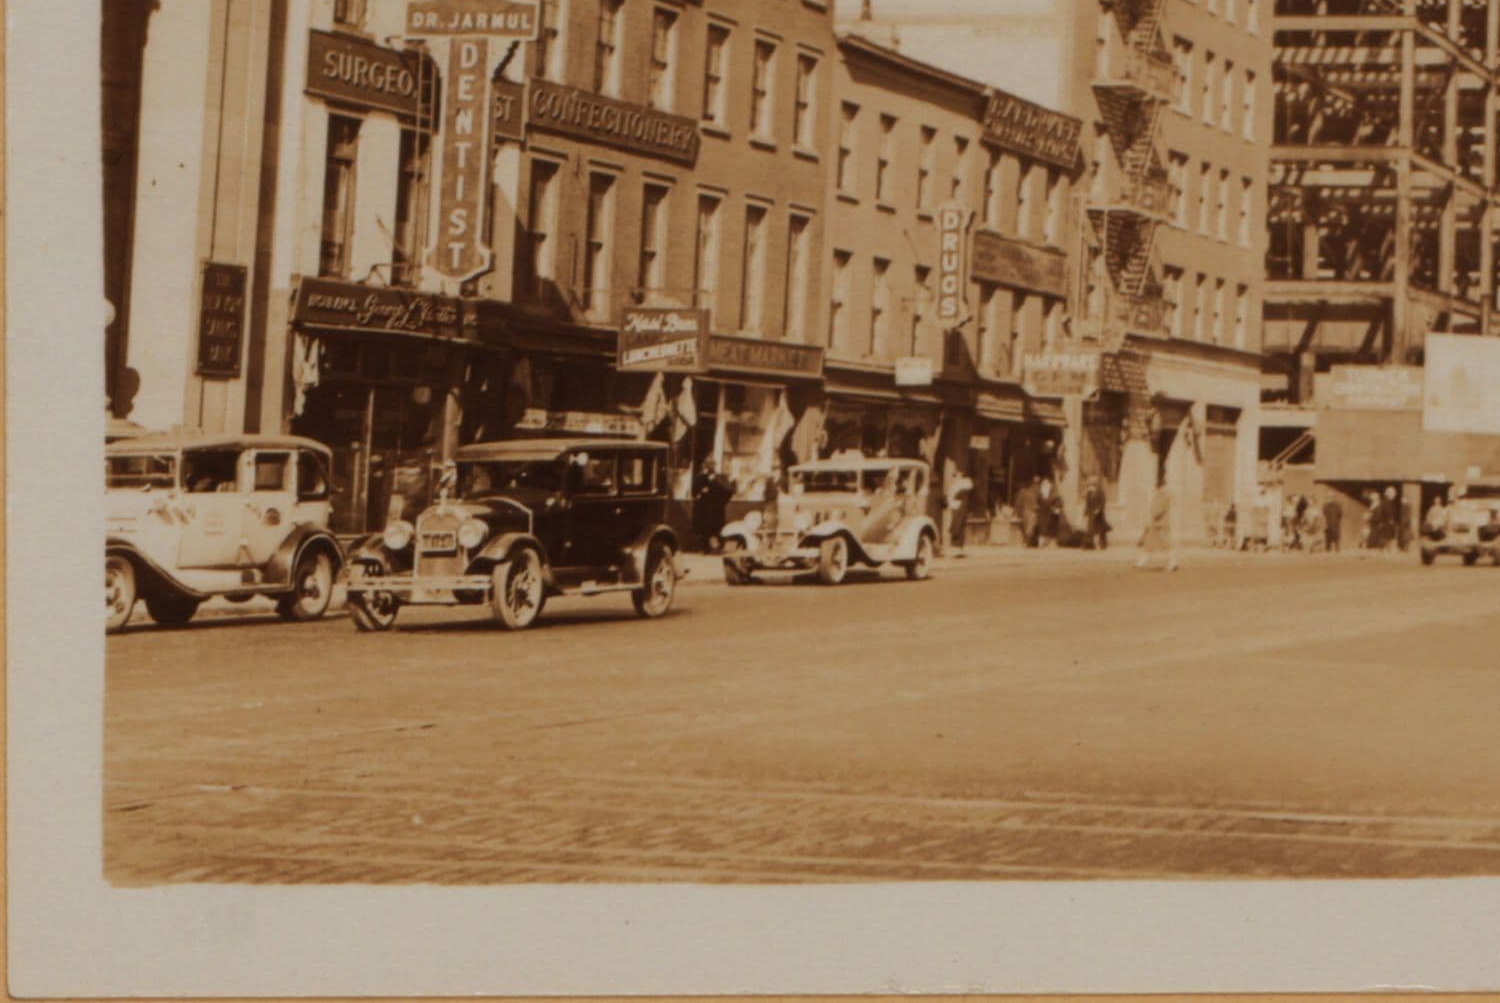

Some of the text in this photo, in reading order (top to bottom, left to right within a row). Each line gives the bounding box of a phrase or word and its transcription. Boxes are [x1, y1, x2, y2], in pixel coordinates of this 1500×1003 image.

[411, 11, 445, 29] DR.
[322, 49, 419, 99] SURGEO
[532, 88, 695, 151] CONFECTIONERY
[448, 42, 479, 270] DENTIST
[940, 211, 959, 317] DRUGS
